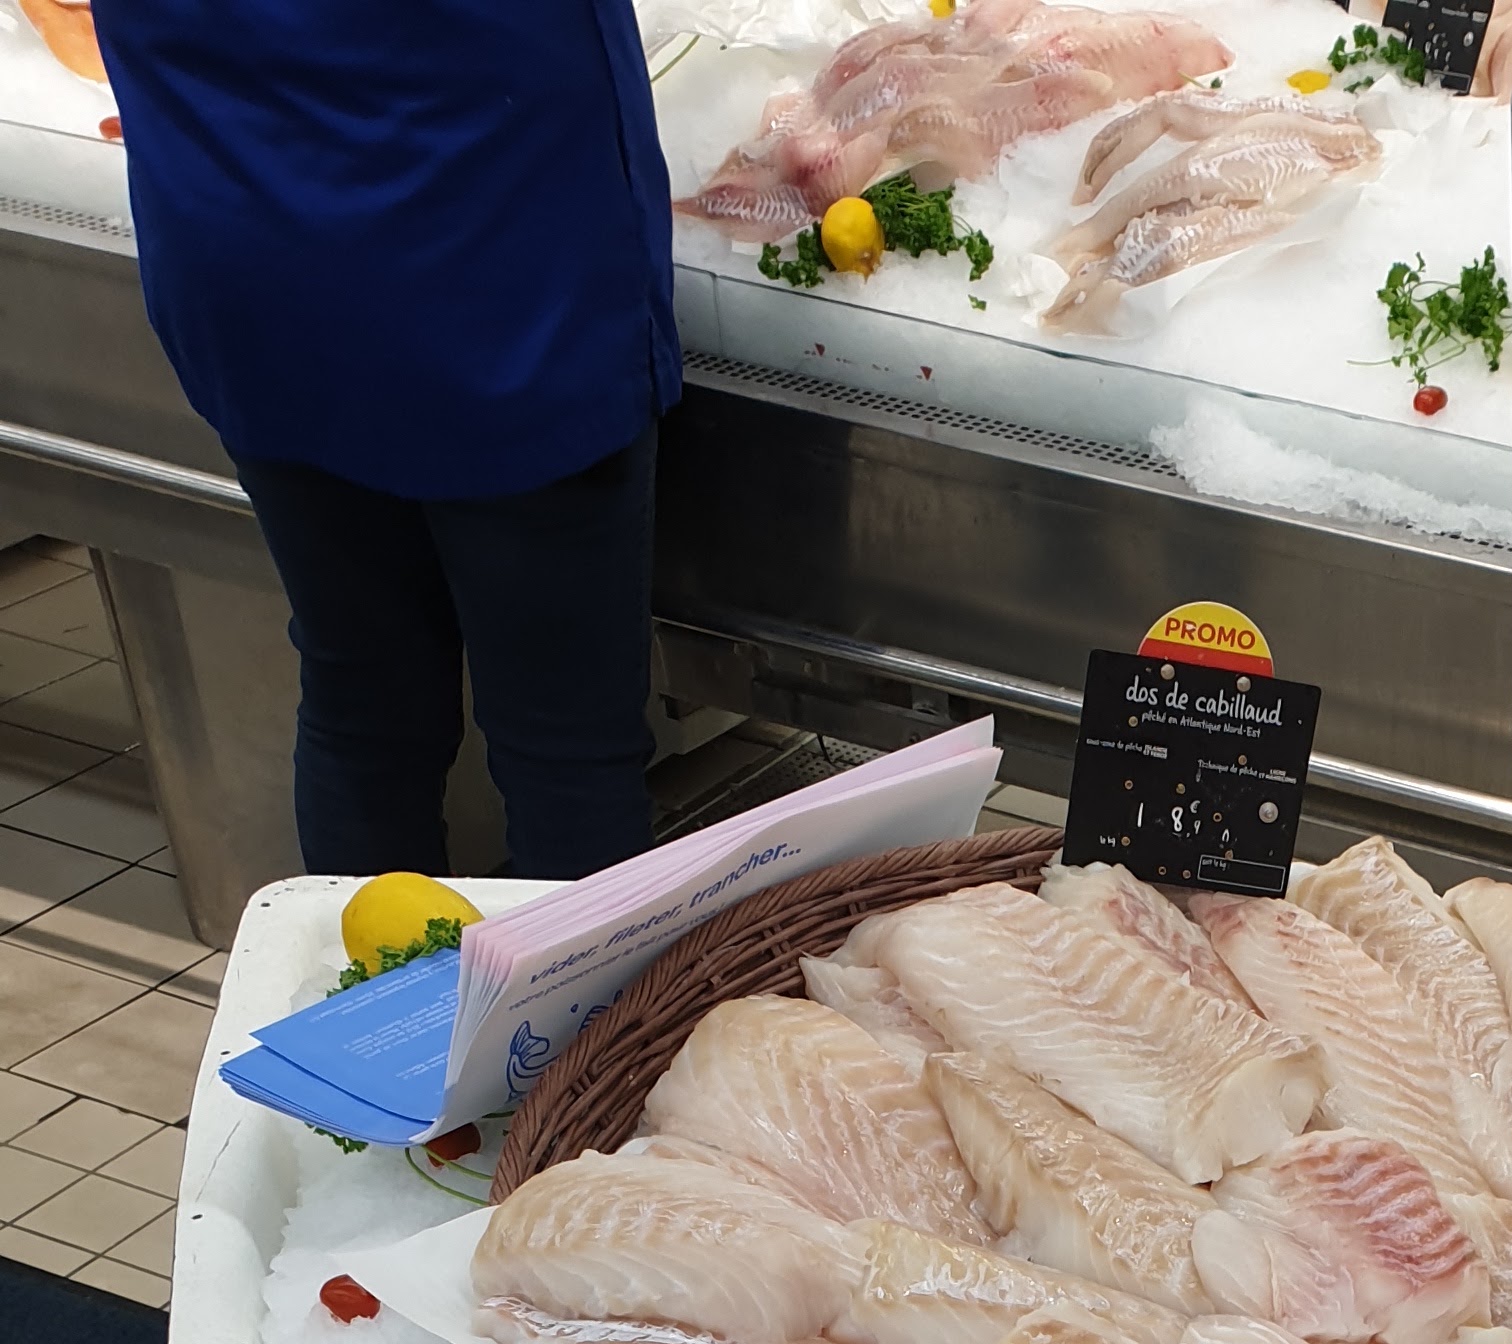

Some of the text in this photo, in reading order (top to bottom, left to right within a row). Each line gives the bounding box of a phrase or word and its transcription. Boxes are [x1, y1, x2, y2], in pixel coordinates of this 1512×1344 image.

[1164, 616, 1256, 650] PROMO
[1125, 674, 1284, 726] dos de cabillaud
[530, 841, 802, 984] vider, fileter, trancher...
